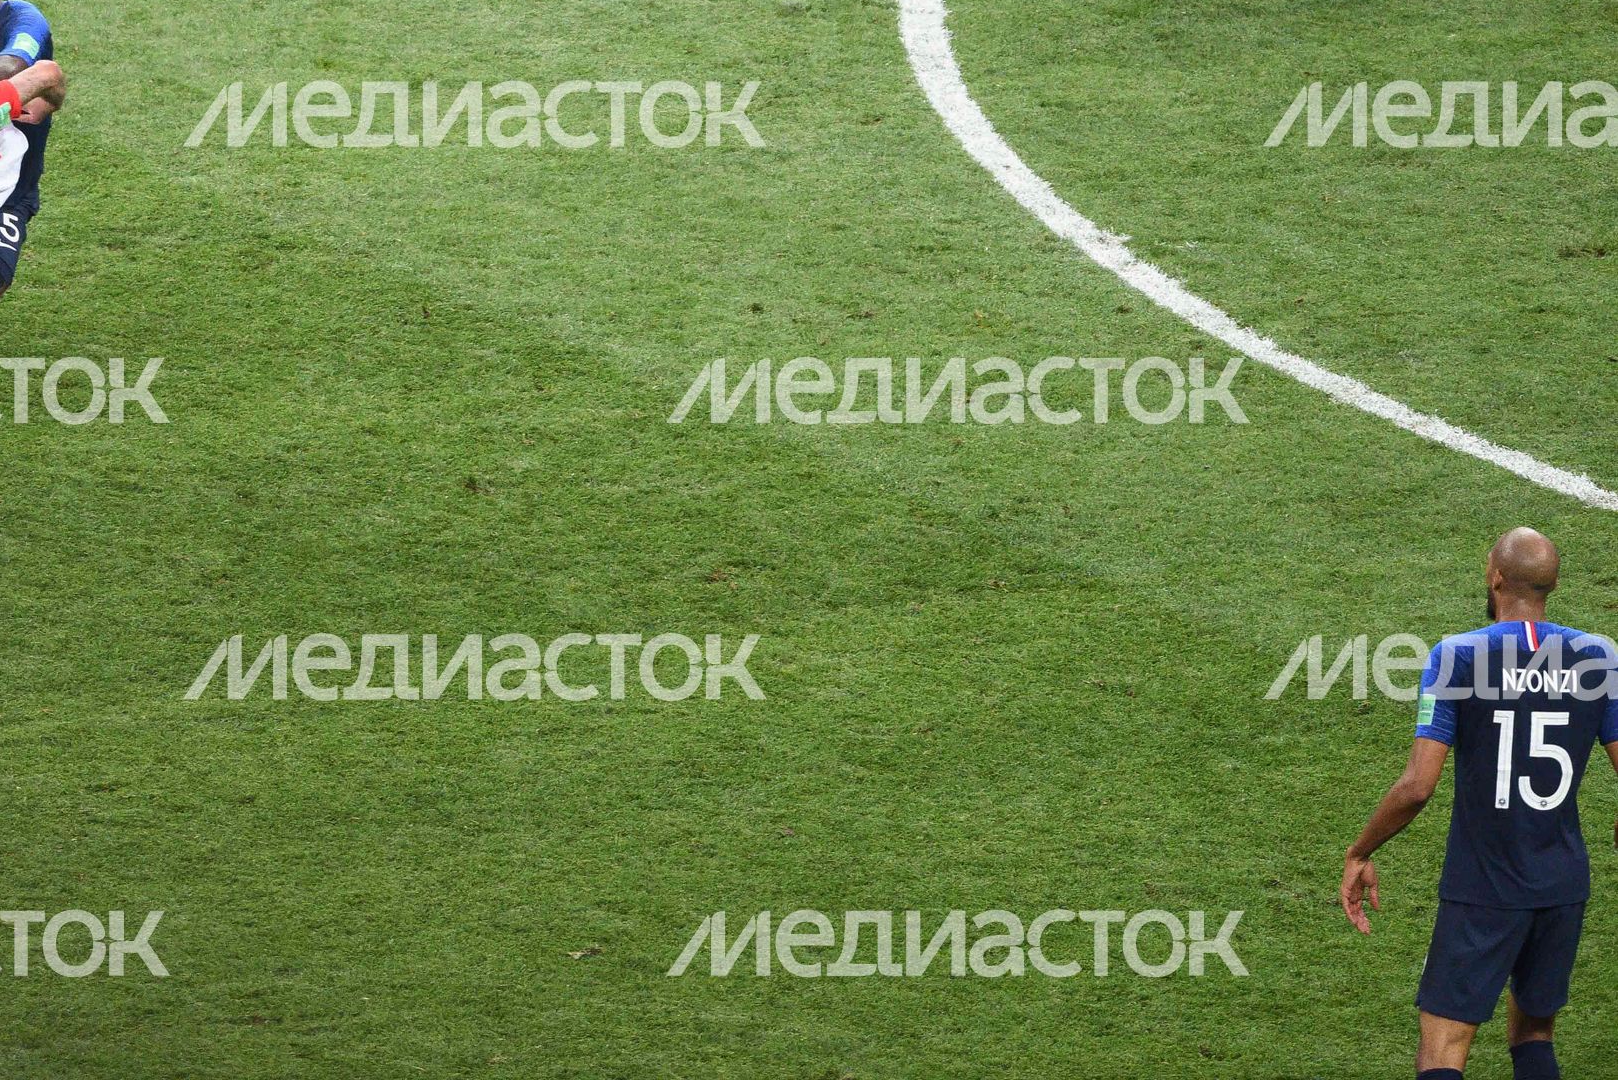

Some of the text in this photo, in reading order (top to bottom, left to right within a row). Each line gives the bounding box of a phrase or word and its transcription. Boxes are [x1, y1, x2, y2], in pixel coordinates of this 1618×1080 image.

[0, 212, 20, 243] 5
[1502, 668, 1578, 693] NZONZI
[1492, 710, 1574, 811] 15
